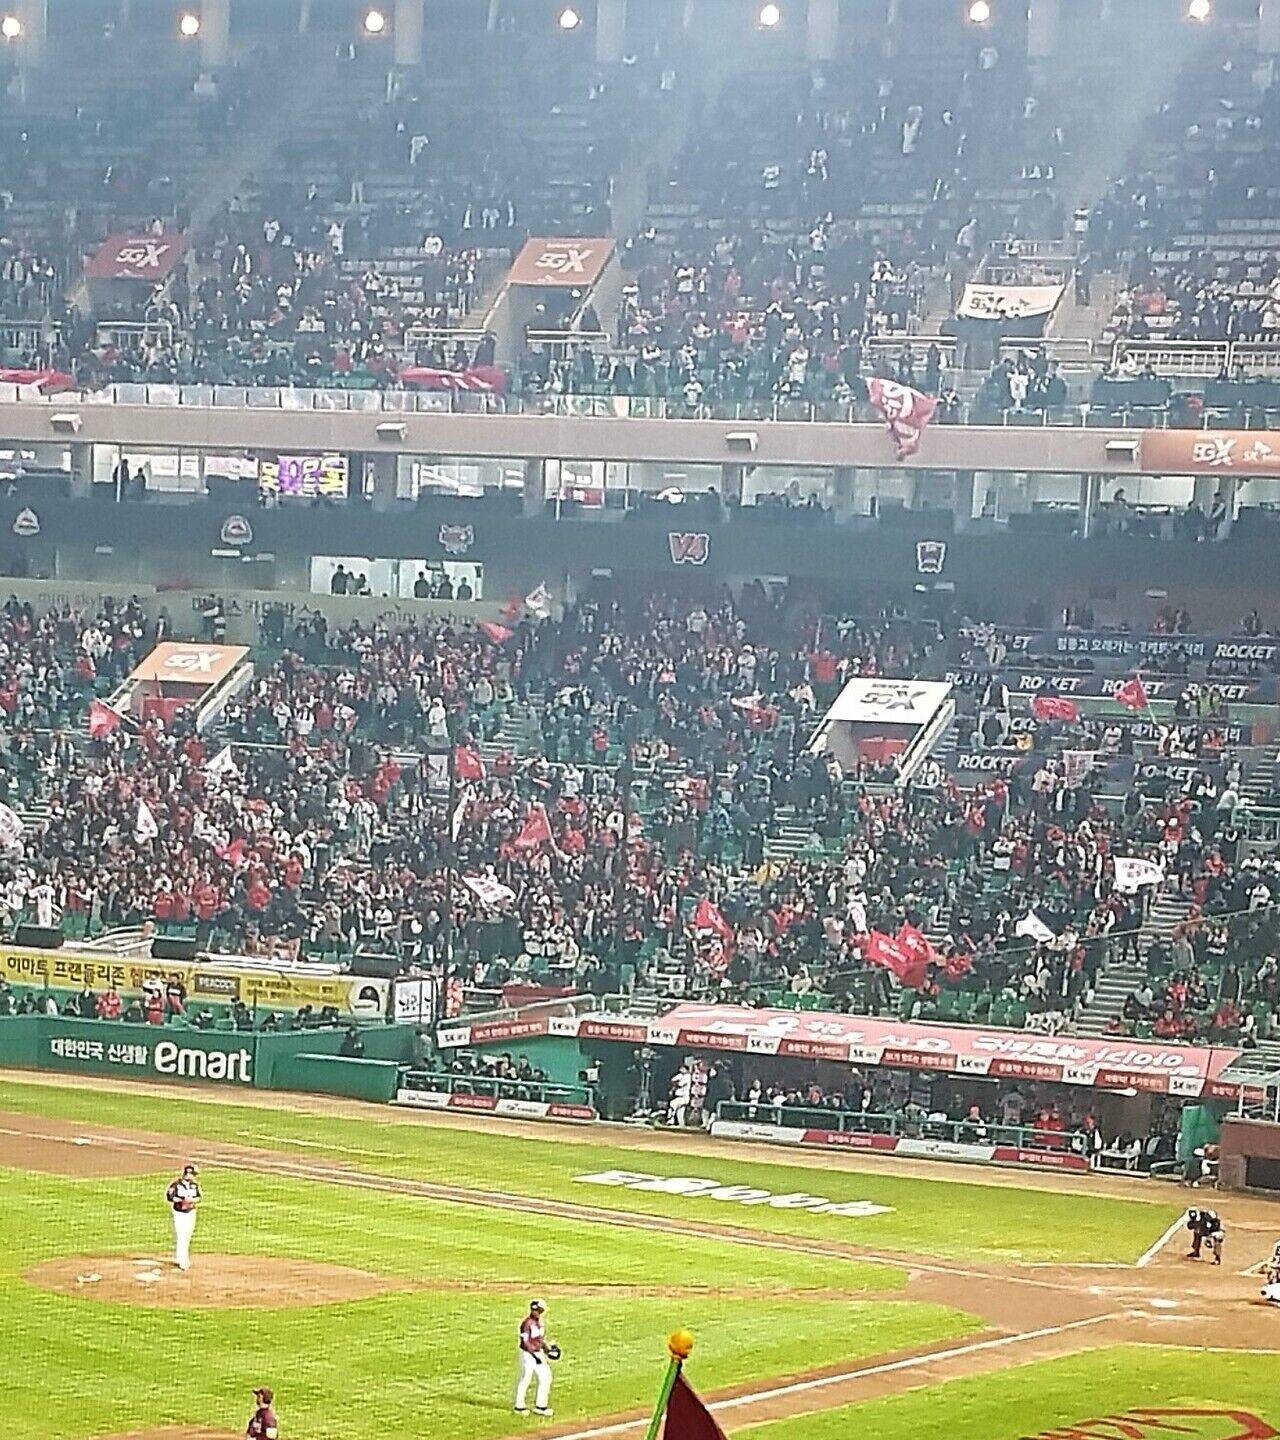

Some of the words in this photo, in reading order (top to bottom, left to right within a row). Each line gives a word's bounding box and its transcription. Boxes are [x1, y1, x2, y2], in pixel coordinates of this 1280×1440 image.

[116, 245, 171, 268] 5GX
[535, 249, 593, 272] 5GX
[1192, 438, 1236, 466] 5GX
[1216, 643, 1277, 660] ROCKET
[6, 956, 50, 979] 이마트
[199, 977, 237, 990] PEACOCK
[51, 1038, 104, 1061] 대한민국
[107, 1042, 149, 1065] 신생활
[154, 1041, 253, 1082] emart
